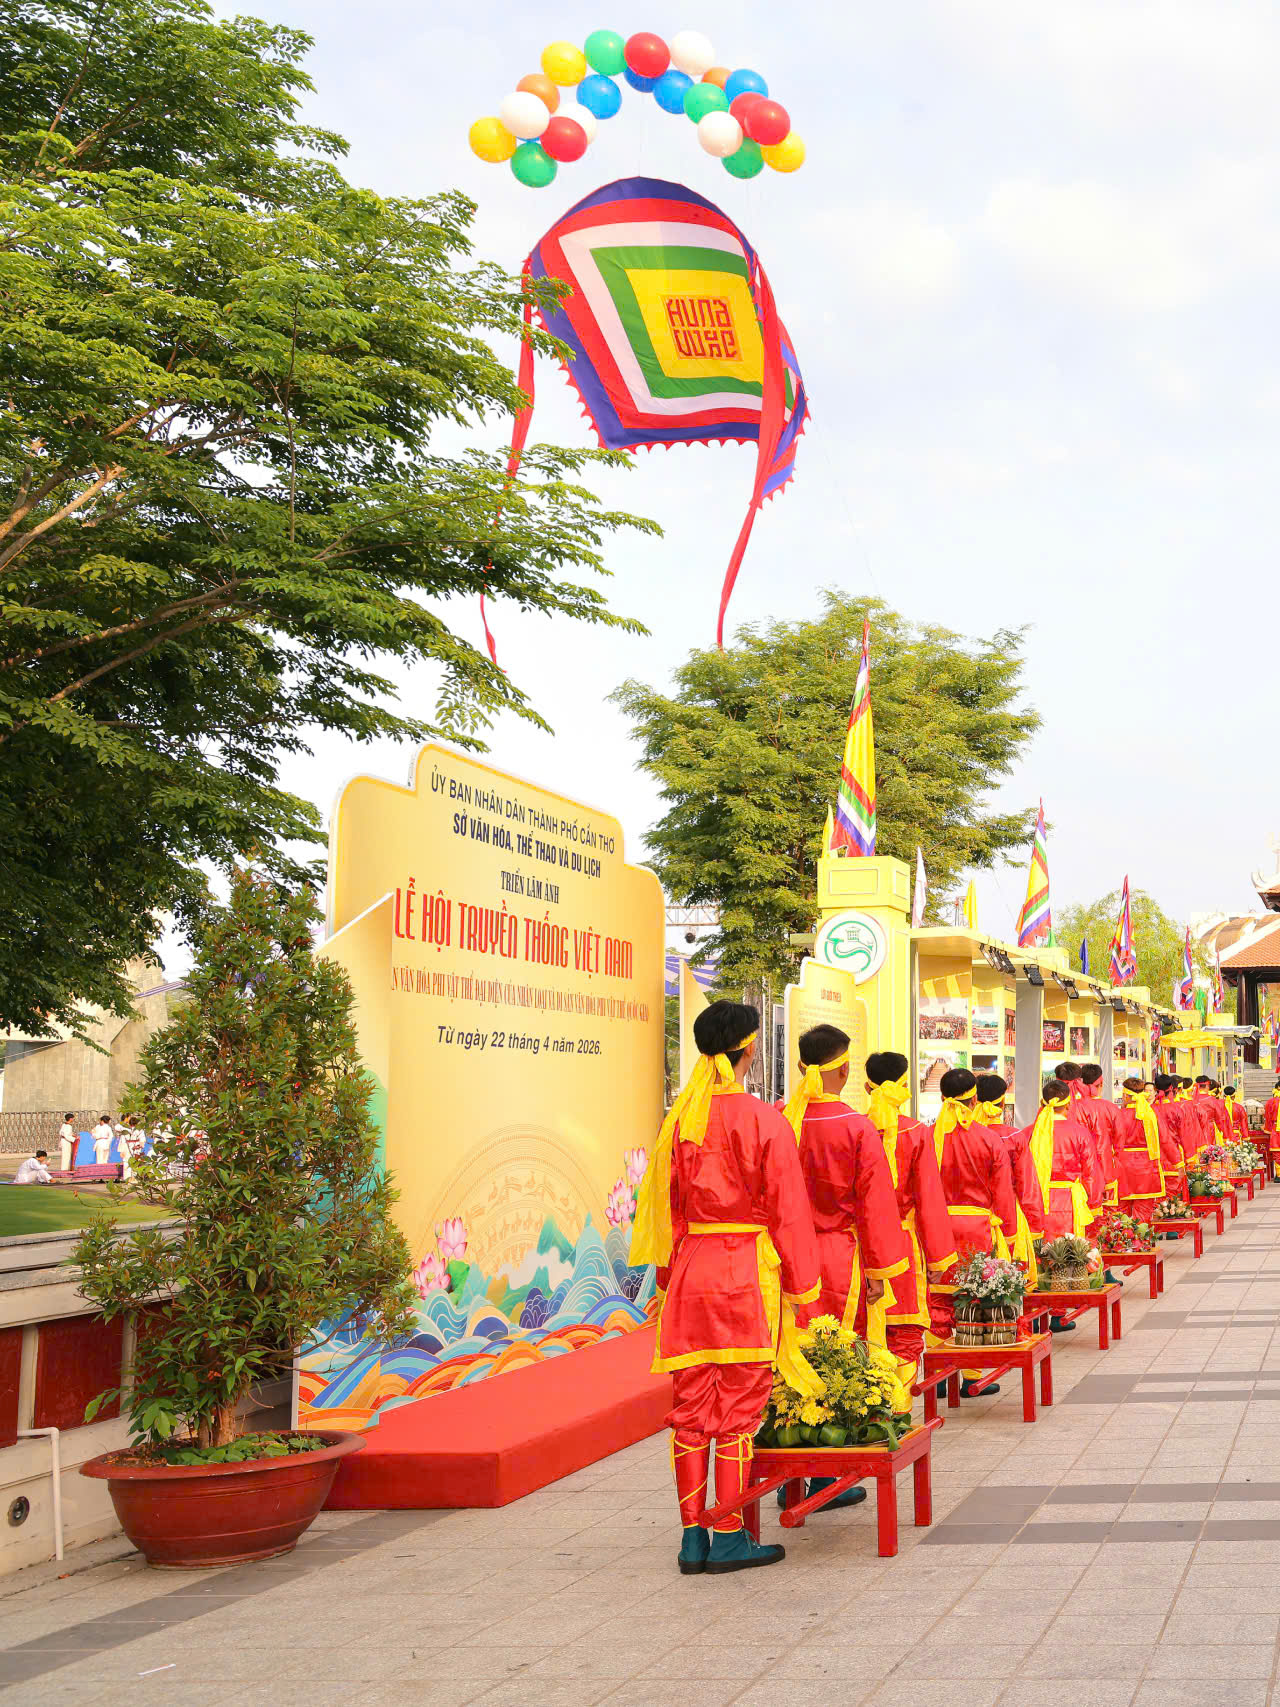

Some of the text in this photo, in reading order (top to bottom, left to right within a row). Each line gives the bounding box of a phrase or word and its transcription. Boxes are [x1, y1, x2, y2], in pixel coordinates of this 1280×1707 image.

[431, 764, 446, 795] ỦY
[449, 778, 472, 805] BAN
[474, 788, 503, 816] NHÂN
[505, 797, 526, 823] DÂN
[528, 807, 558, 835] THÀNH
[560, 818, 578, 842] PHỐ
[599, 833, 615, 855] THƠ
[453, 808, 601, 880] SỞ VĂN HÓA, THỂ THAO VÀ DU LỊCH
[501, 868, 560, 904] TRIỂN LÃM ẢNH
[395, 876, 633, 980] LỄ HỘI TRUYỀN THỐNG VIỆT NAM
[400, 965, 415, 993] VĂN
[416, 966, 431, 995] HÓA
[432, 972, 445, 997] PHI
[447, 971, 460, 1004] VẬT
[437, 1025, 602, 1055] Từ ngày 22 tháng 4 năm 2026.
